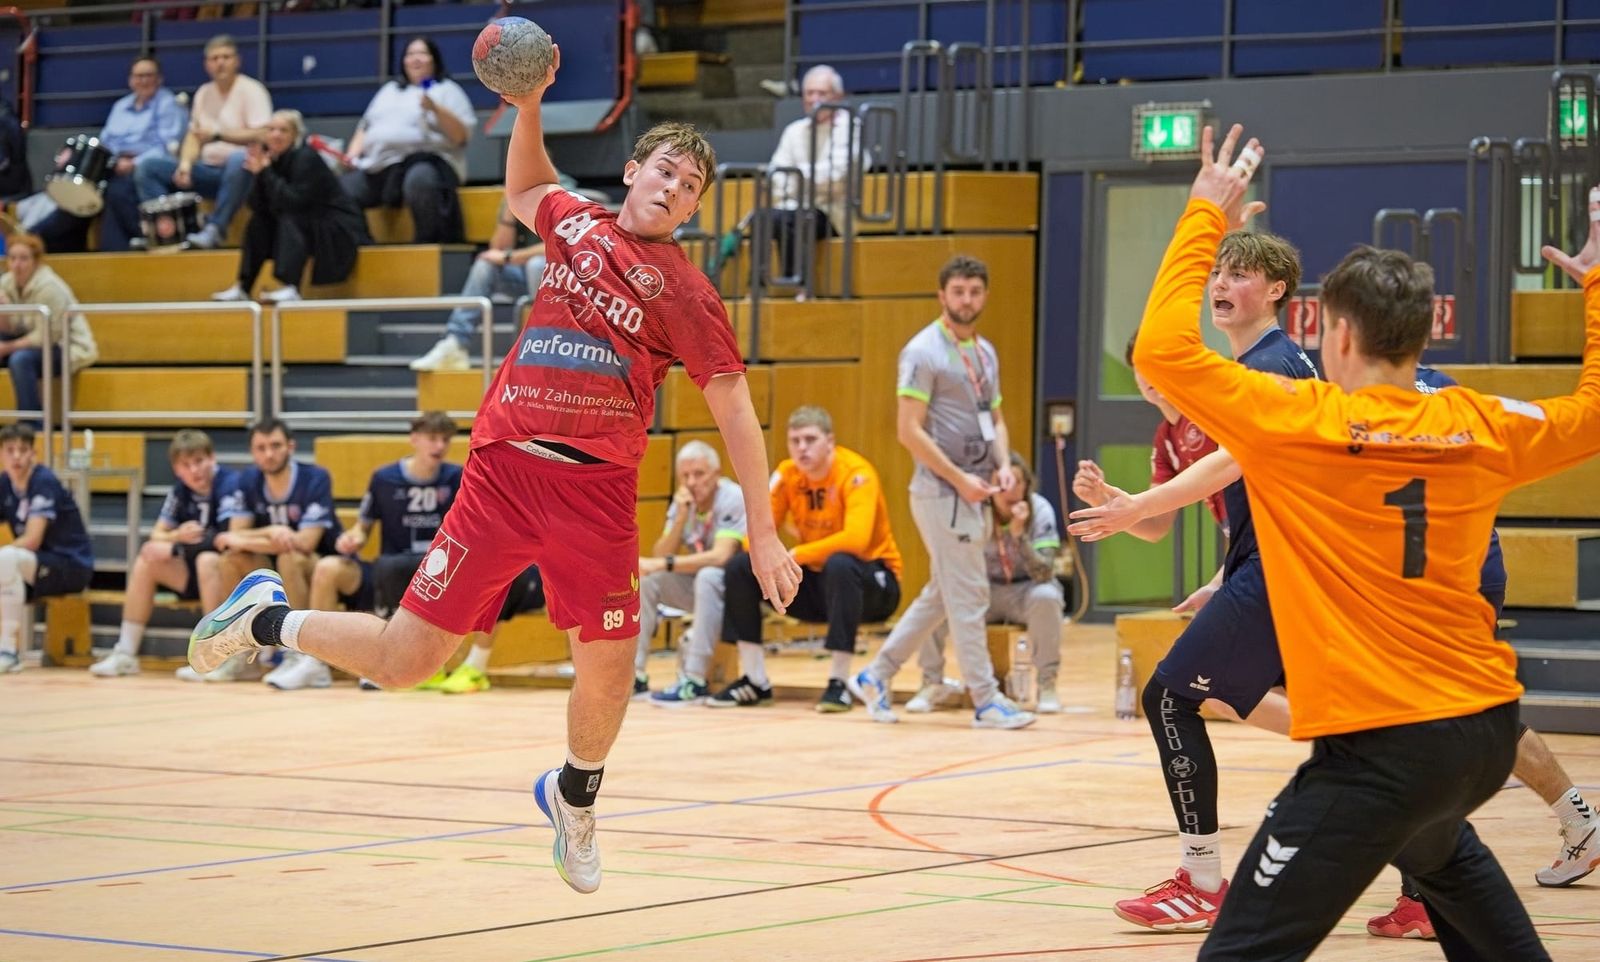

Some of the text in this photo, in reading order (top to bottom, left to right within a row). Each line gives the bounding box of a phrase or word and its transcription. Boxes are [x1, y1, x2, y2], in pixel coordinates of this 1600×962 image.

[544, 388, 636, 411] Zahnmedizin
[406, 485, 438, 513] 20
[1383, 478, 1428, 579] 1
[603, 609, 625, 631] 89
